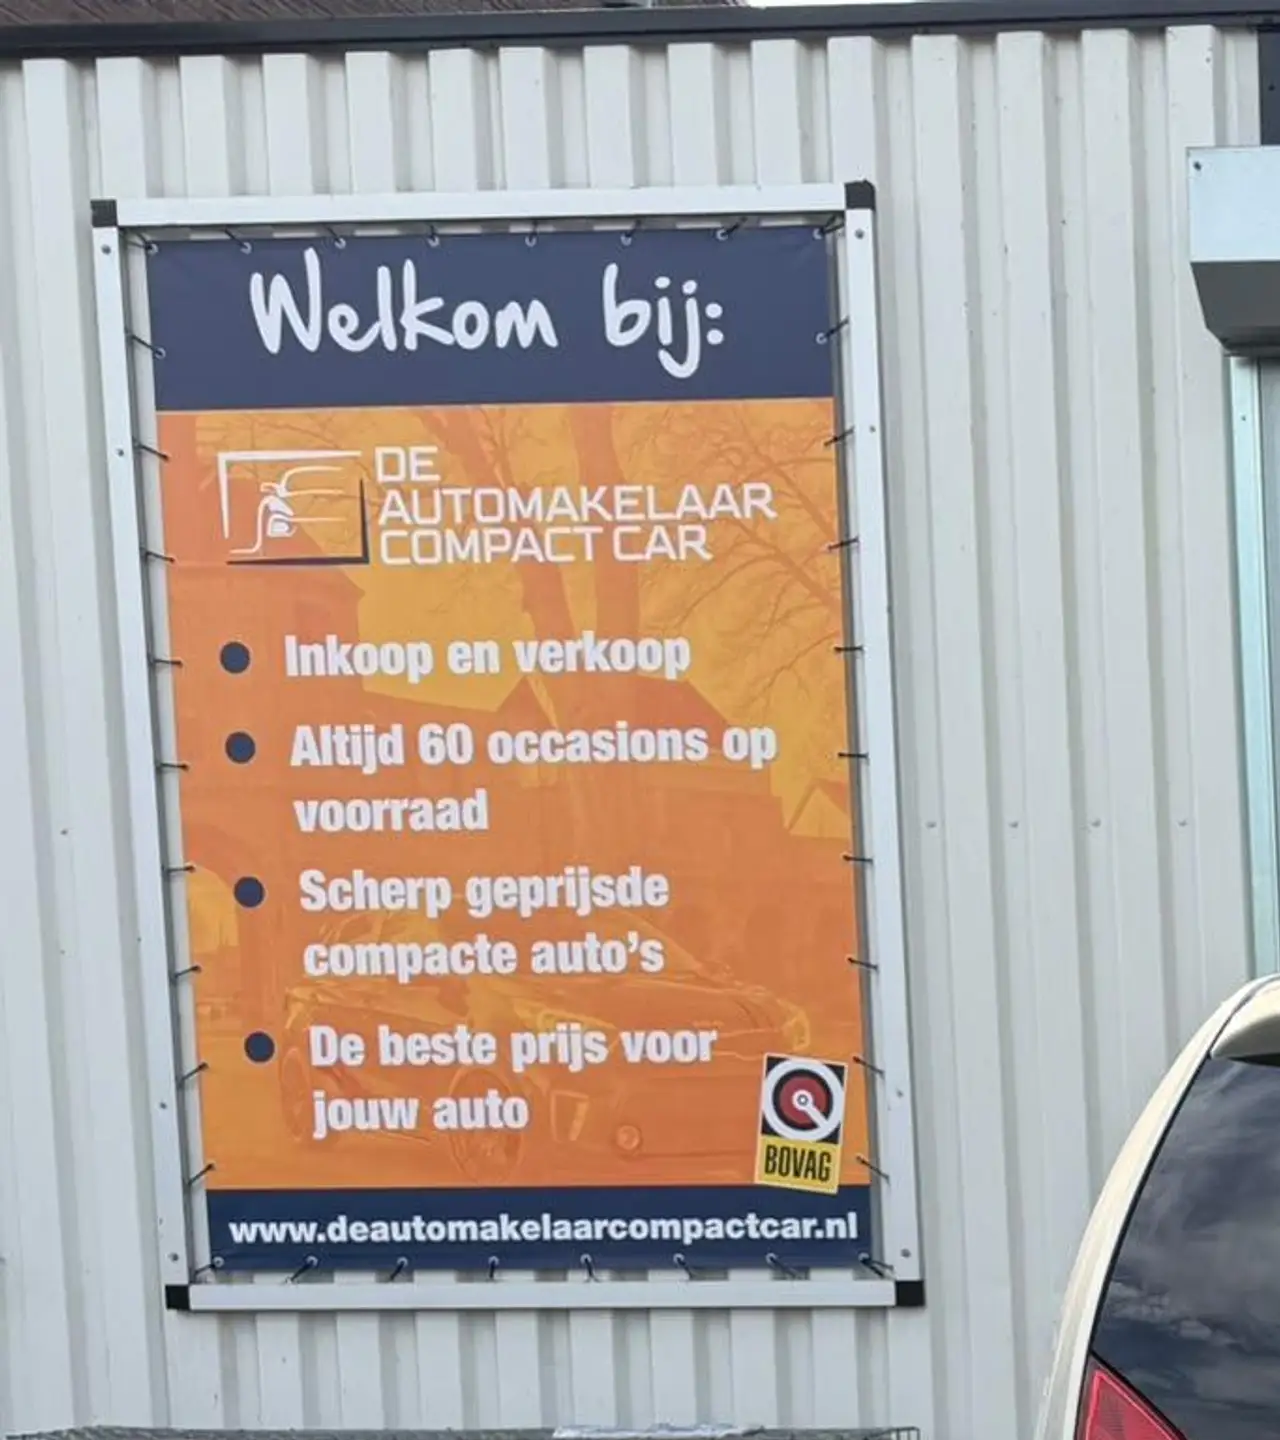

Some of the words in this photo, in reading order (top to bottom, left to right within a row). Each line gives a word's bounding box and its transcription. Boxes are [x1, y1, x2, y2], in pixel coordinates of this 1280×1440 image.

[249, 247, 558, 355] Welkom
[602, 262, 724, 378] bij:
[376, 446, 441, 482] DE
[378, 482, 776, 526] AUTOMAKELAAR
[380, 526, 602, 566] COMPACT
[613, 524, 712, 561] CAR
[285, 635, 434, 683] Inkoop
[448, 640, 500, 675] en
[513, 631, 690, 682] verkoop
[290, 724, 404, 771] Altijd
[418, 724, 472, 763] 60
[488, 721, 708, 764] occasions
[724, 726, 777, 770] op
[294, 788, 489, 833] voorraad
[299, 870, 452, 916] Scherp
[465, 866, 669, 917] geprijsde
[303, 939, 517, 983] compacte
[531, 931, 664, 975] auto's
[309, 1026, 364, 1067] De
[379, 1023, 497, 1066] beste
[511, 1023, 608, 1073] prijs
[622, 1026, 717, 1063] voor
[311, 1090, 418, 1141] jouw
[432, 1093, 529, 1132] auto
[763, 1144, 832, 1184] BOVAG
[229, 1212, 859, 1246] www.deautomakelaarcompactcar.nl
